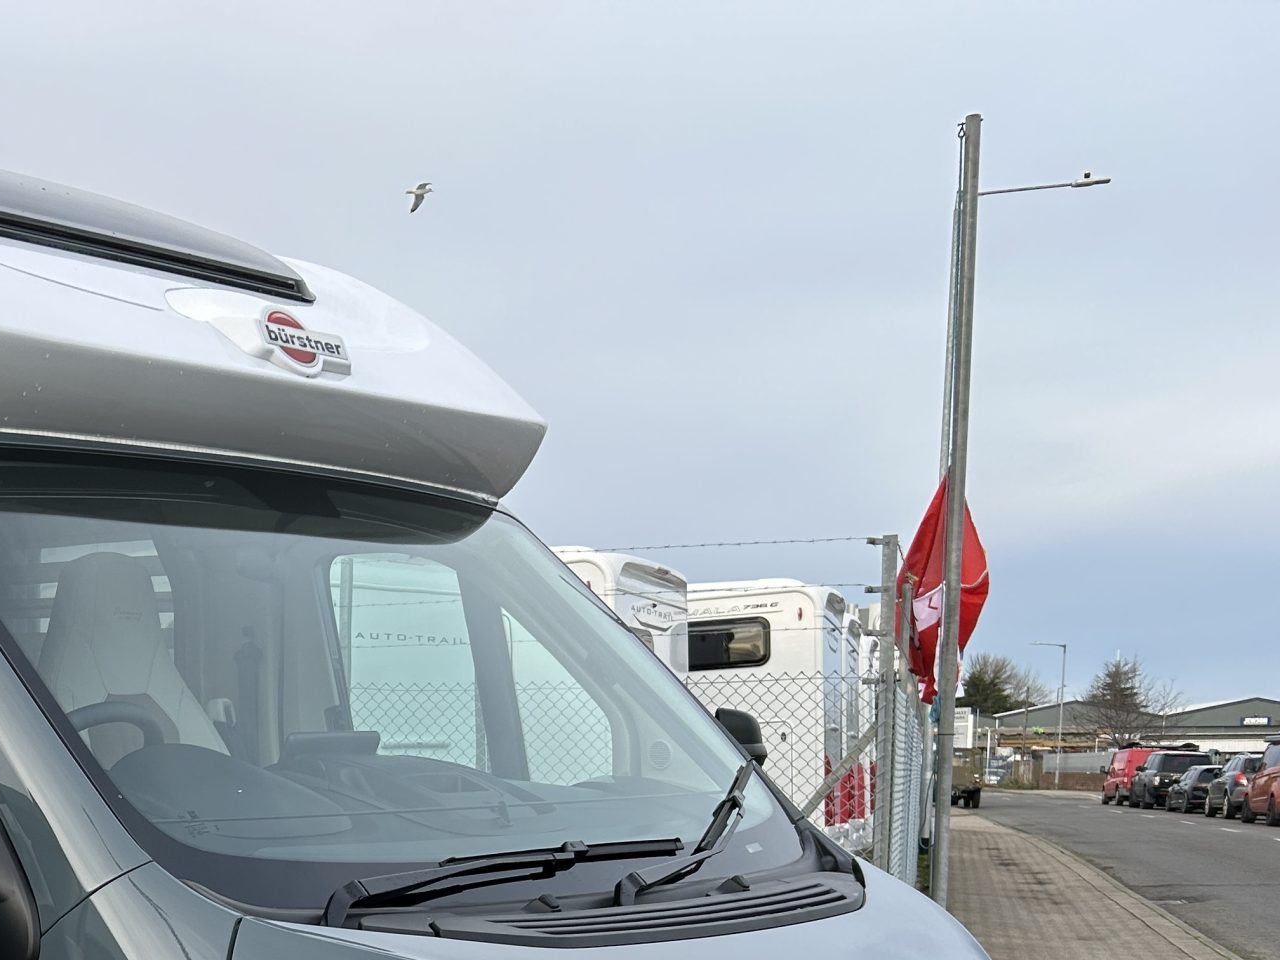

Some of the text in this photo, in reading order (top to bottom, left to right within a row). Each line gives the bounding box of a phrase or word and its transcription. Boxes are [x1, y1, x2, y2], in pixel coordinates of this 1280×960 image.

[265, 324, 341, 355] bürstner
[631, 604, 674, 622] AUTO-TRAIL
[355, 631, 468, 646] AUTO-TRAIL
